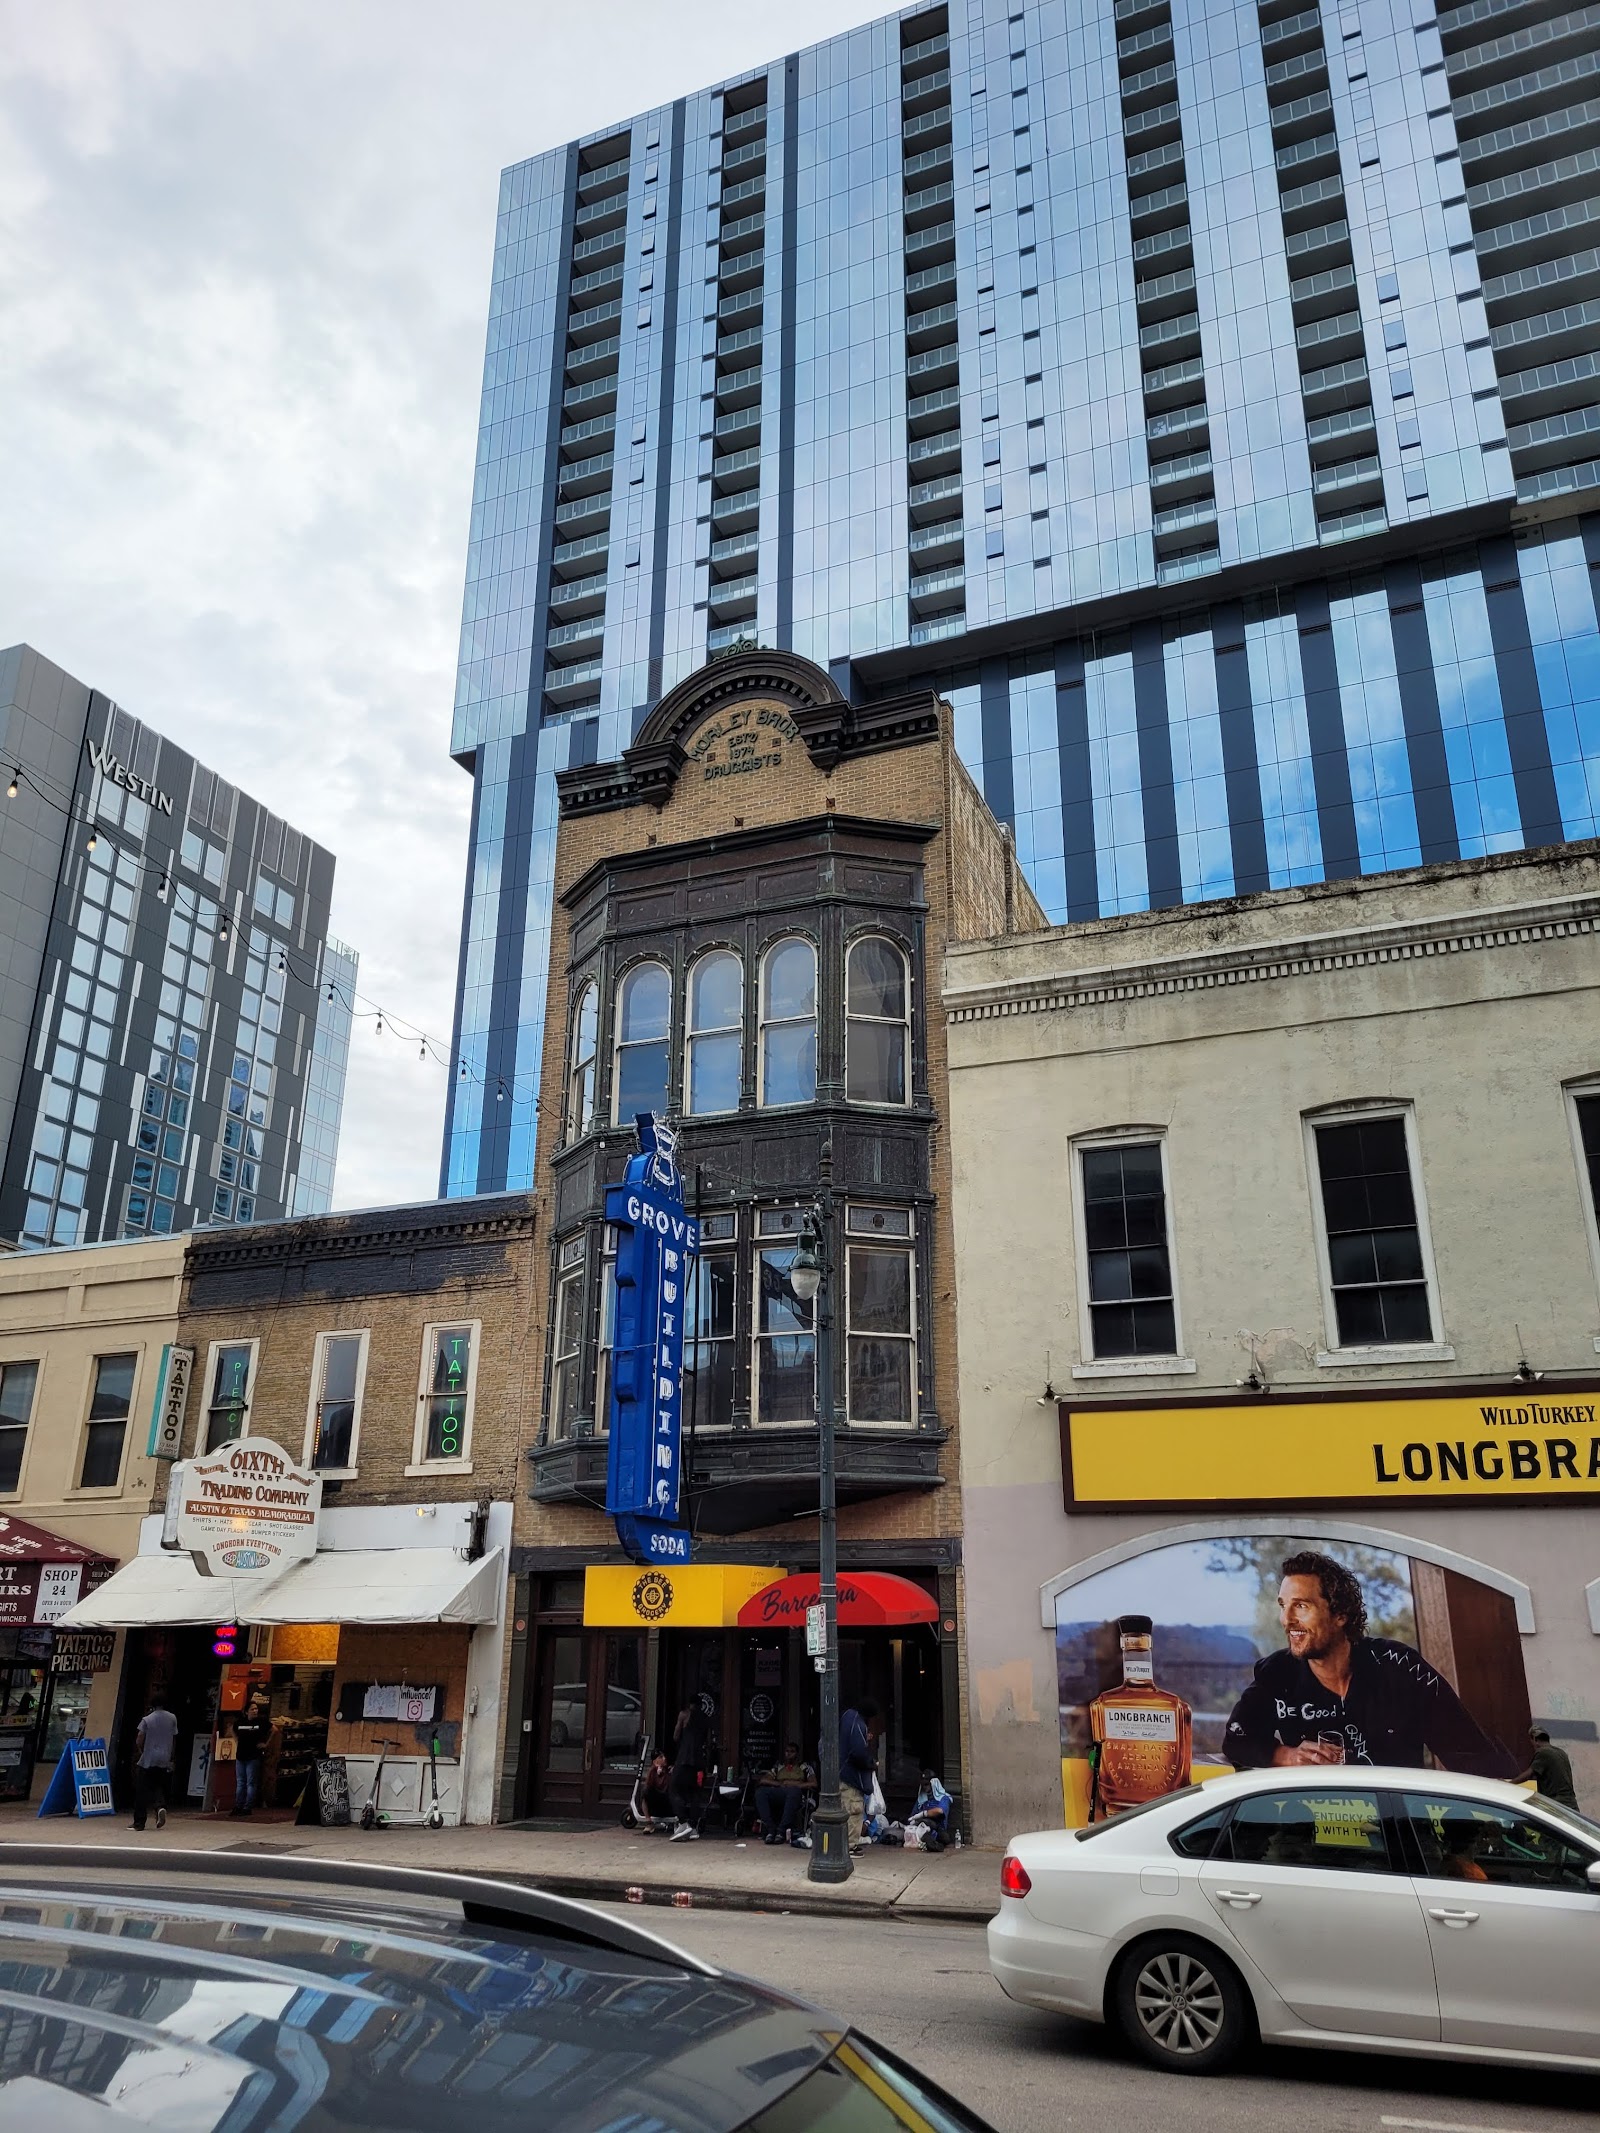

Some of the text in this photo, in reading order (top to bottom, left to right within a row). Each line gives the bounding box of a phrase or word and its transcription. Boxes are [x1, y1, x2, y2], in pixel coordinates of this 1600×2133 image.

[704, 753, 782, 780] DRUGGISTS
[86, 738, 173, 817] WESTIN
[627, 1195, 696, 1249] GROVE
[655, 1248, 680, 1505] BUILDING
[164, 1358, 188, 1441] TATTOO
[442, 1339, 463, 1453] TATTOO
[1480, 1403, 1596, 1425] WILD TURKEY
[232, 1471, 281, 1482] STREET
[201, 1480, 310, 1506] TRADING COMPANY
[190, 1503, 220, 1513] AUSTIN
[229, 1506, 256, 1516] TEXAS
[257, 1509, 311, 1522] MEMORABILIA
[212, 1538, 282, 1556] LONGHORN EVERYTHING
[650, 1532, 685, 1557] SODA
[43, 1570, 78, 1582] SHOP
[638, 1576, 667, 1589] THE BEE
[52, 1585, 67, 1596] 24
[637, 1602, 667, 1617] GROCERY
[760, 1587, 859, 1621] Barcena
[55, 1634, 113, 1653] TATTOO
[217, 1644, 232, 1653] ATM
[51, 1654, 110, 1672] PIERCING
[1108, 1711, 1171, 1723] LONGBRANCH
[1106, 1742, 1176, 1753] SMALL BATCH
[76, 1750, 105, 1769] TATTOO
[1117, 1762, 1168, 1772] AMERICAN
[81, 1785, 110, 1806] STUDIO
[1322, 1826, 1350, 1836] WITH
